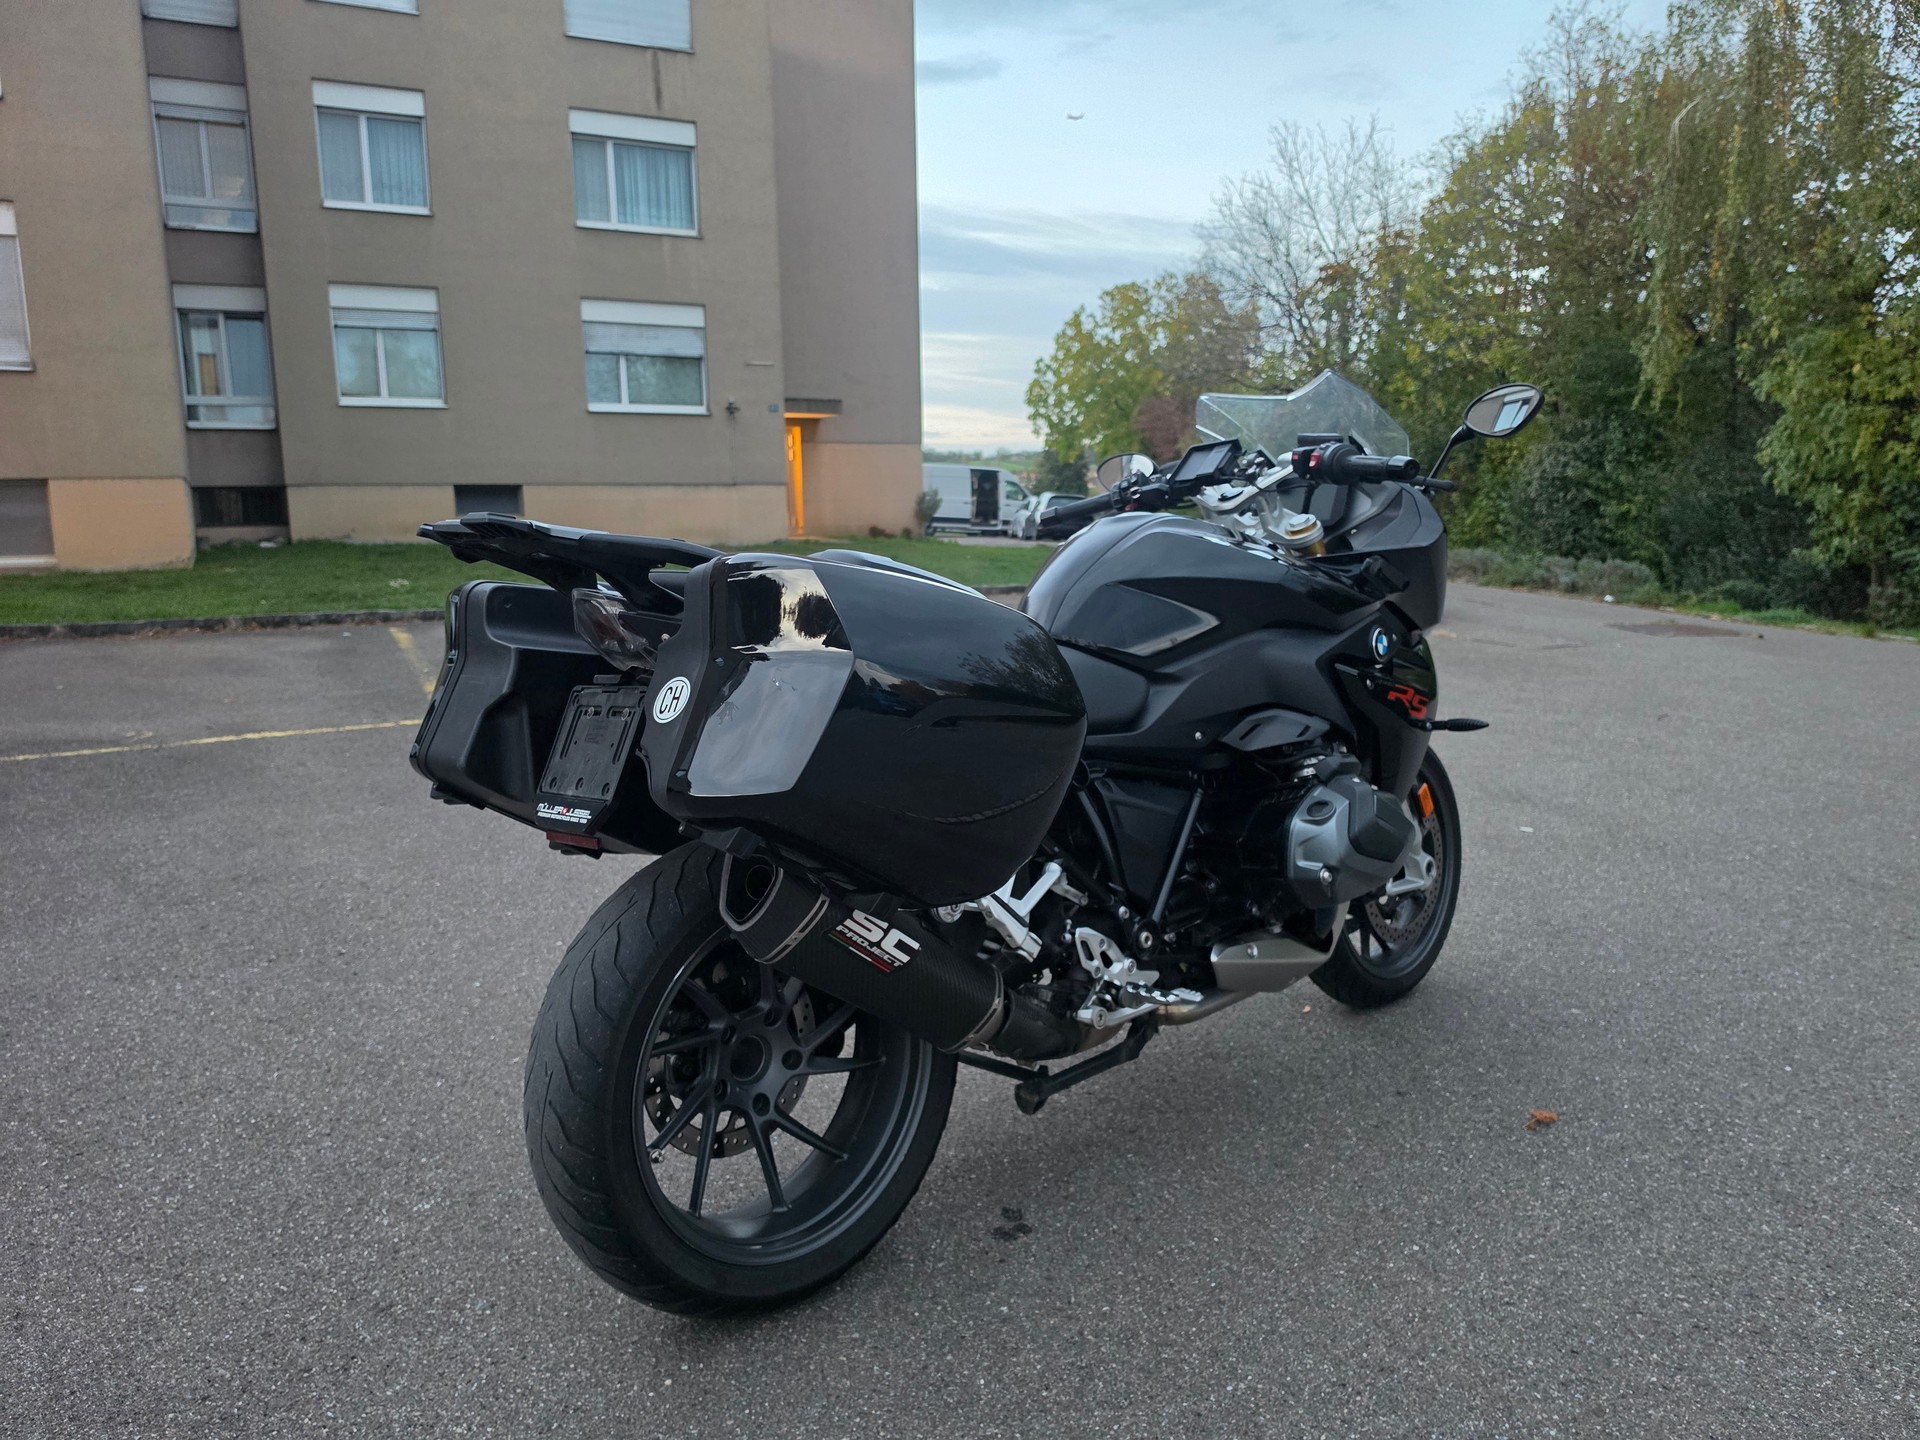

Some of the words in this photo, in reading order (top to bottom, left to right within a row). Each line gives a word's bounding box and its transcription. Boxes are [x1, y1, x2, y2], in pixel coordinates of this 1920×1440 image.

[659, 685, 685, 714] CH
[1387, 684, 1430, 719] RS
[835, 925, 904, 967] PROJECT
[843, 909, 920, 963] SC
